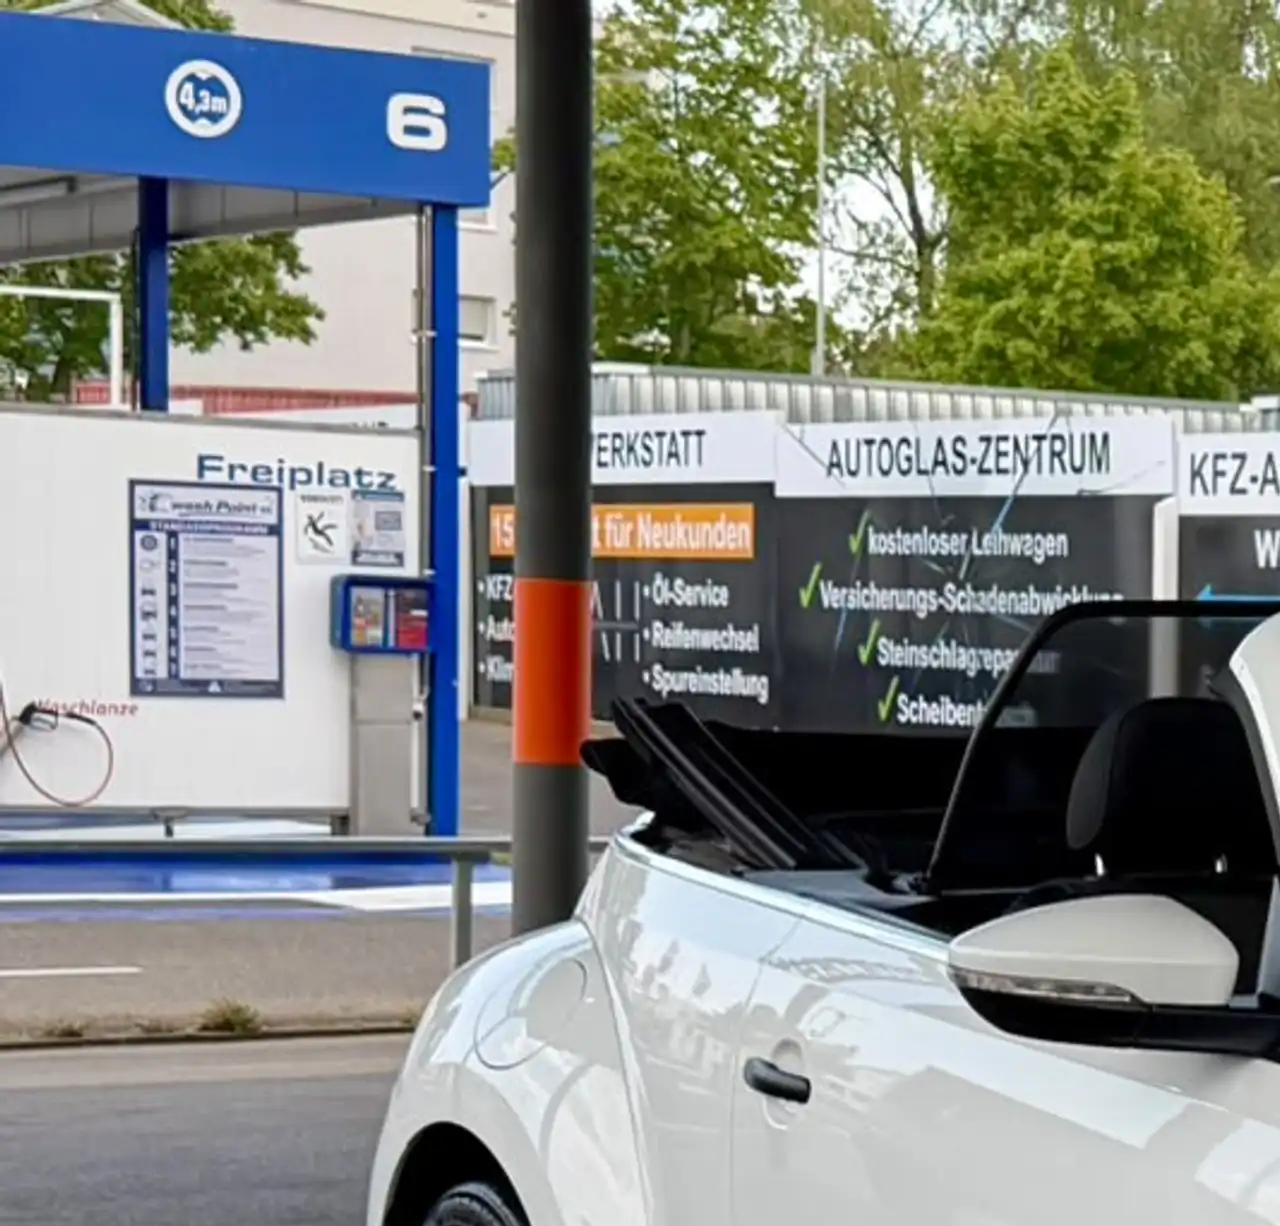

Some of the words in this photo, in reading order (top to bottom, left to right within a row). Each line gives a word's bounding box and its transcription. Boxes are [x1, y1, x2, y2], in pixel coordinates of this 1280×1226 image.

[179, 80, 228, 116] 4,3m
[387, 92, 447, 151] 6
[590, 429, 706, 470] ERKSTATT
[826, 431, 1111, 478] AUTOGLAS-ZENTRUM
[197, 453, 398, 492] Freiplatz
[605, 513, 634, 549] für
[637, 513, 750, 549] Neukunden
[868, 525, 970, 557] kostenloser
[972, 527, 1069, 565] Leihwagen
[652, 572, 729, 608] Öl-Service
[820, 579, 1125, 622] Versicherungs-Schadenabwickl
[652, 619, 759, 653] Reifenwechsel
[652, 663, 769, 705] Spureinstellung
